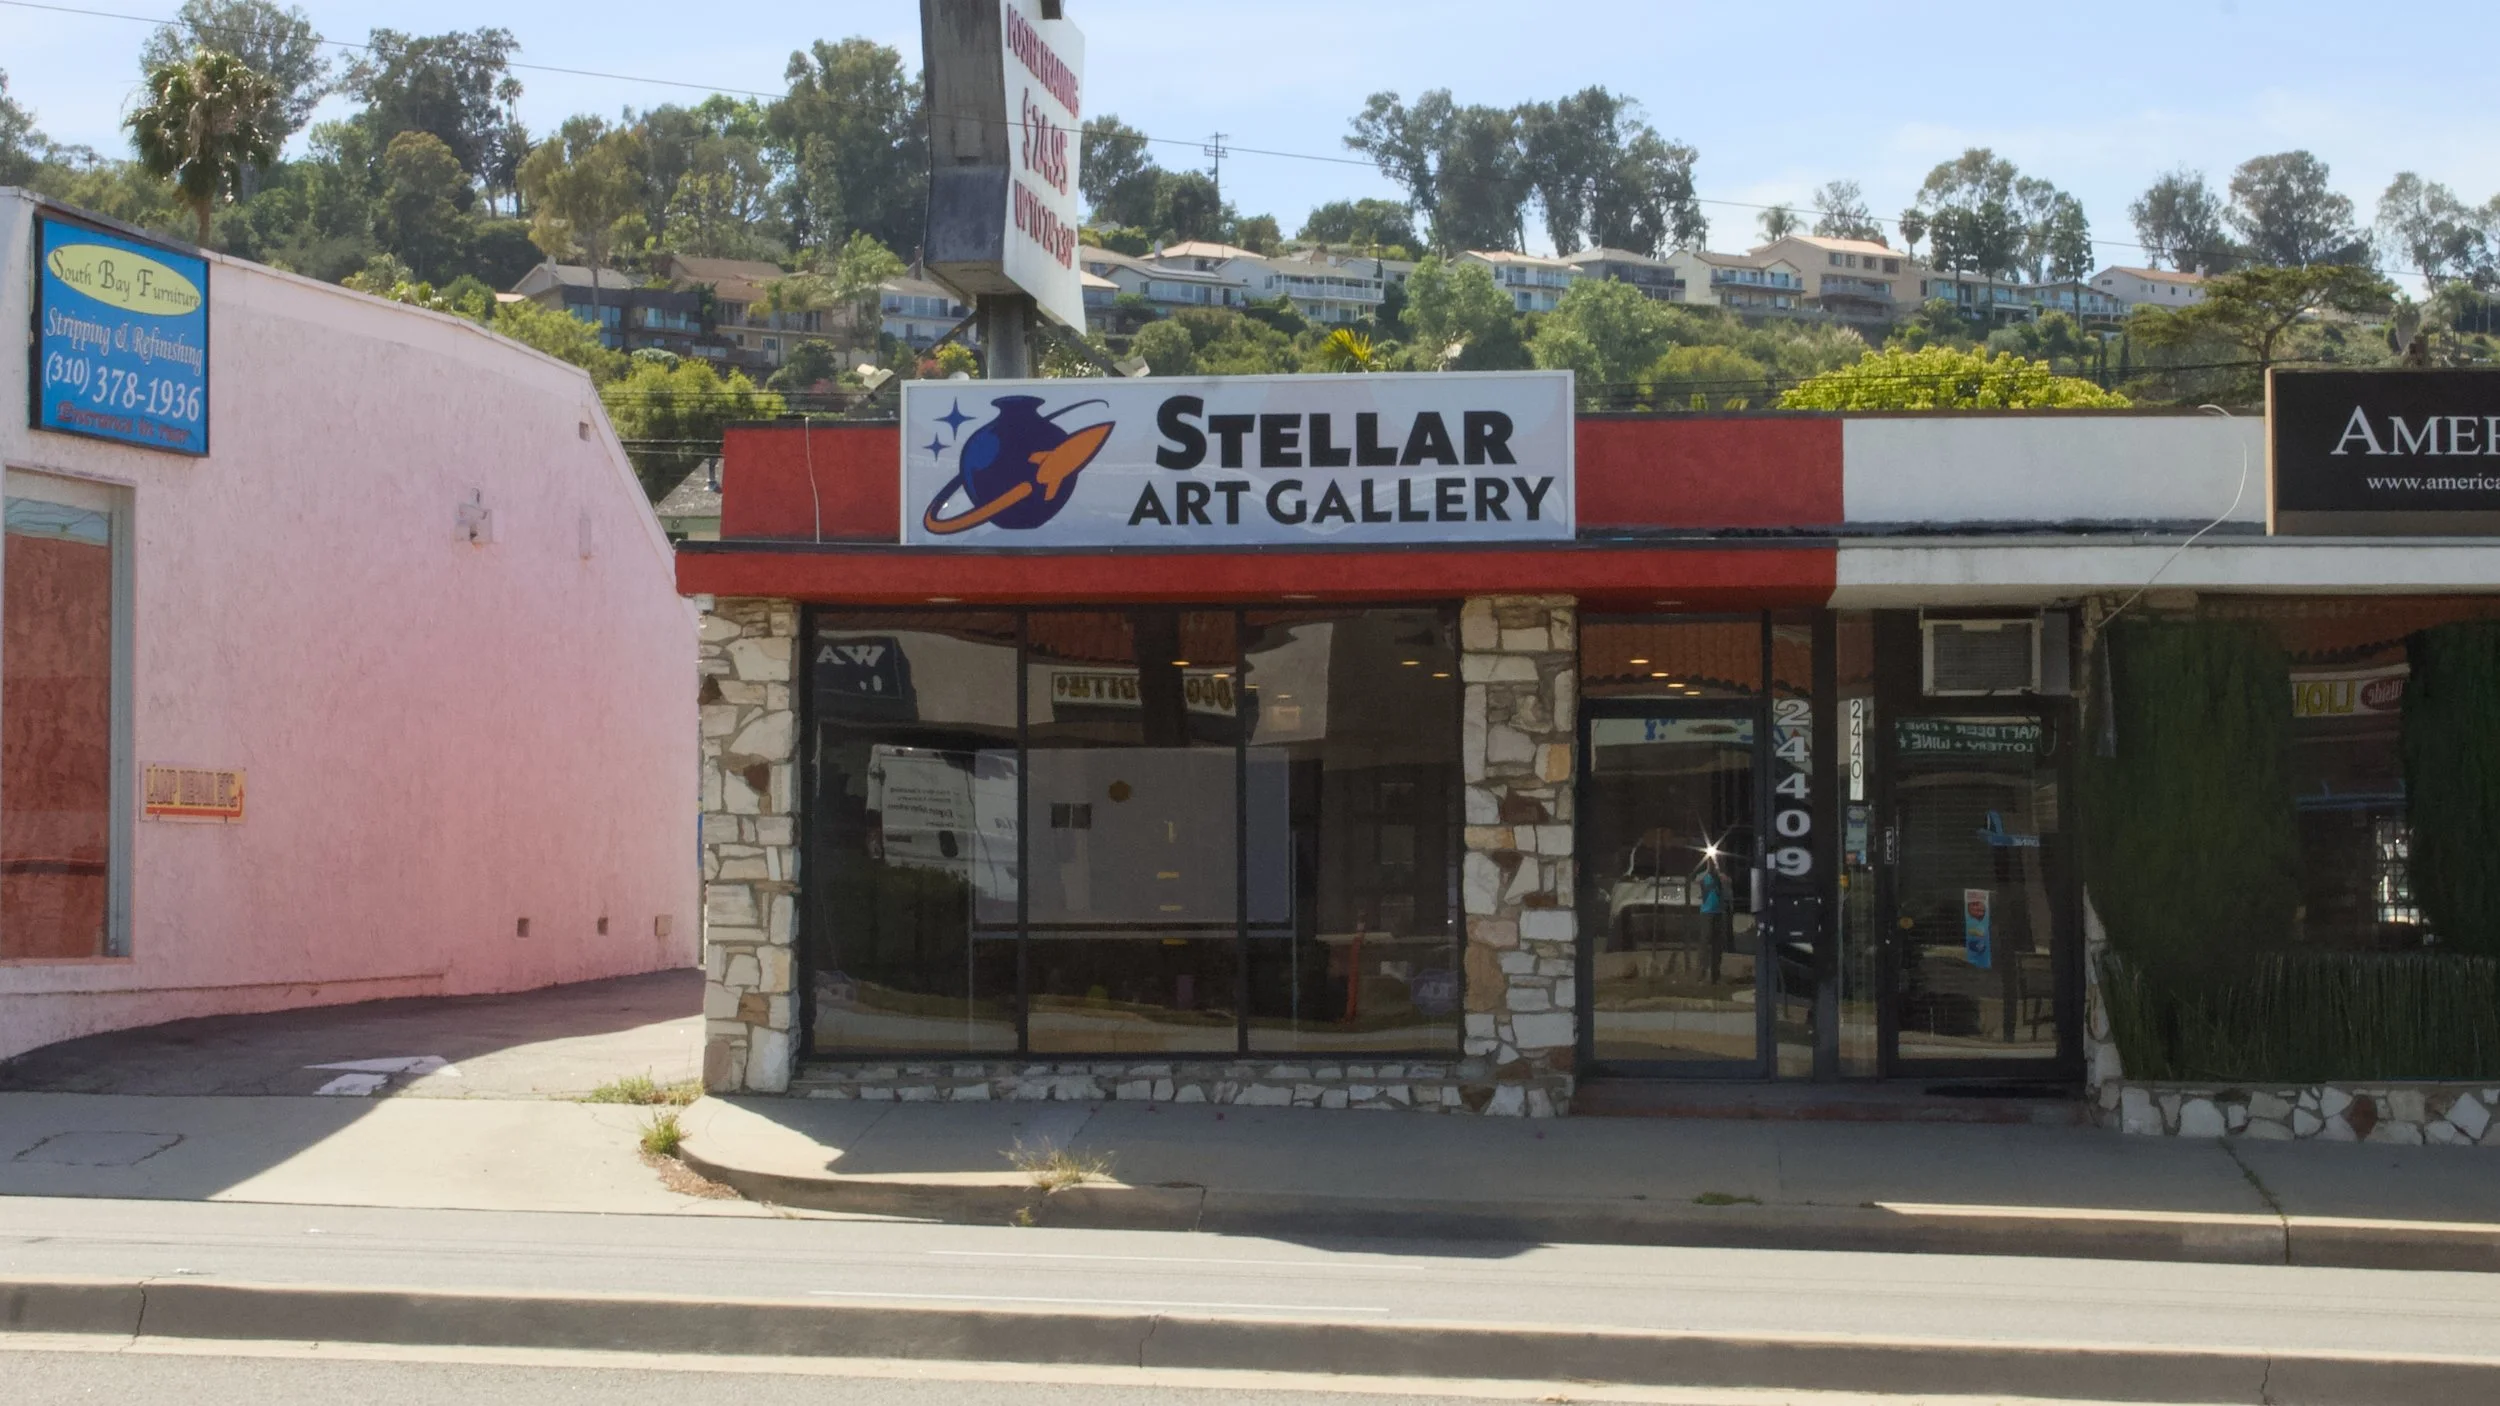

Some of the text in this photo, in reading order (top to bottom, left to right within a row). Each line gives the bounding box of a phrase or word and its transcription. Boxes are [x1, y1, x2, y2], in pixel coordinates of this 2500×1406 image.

[1007, 3, 1079, 119] POSTER FRAMING
[52, 249, 201, 309] South Bay Furniture
[45, 306, 111, 357] Stripping
[133, 326, 203, 376] Refinishing
[45, 350, 202, 422] (310) 378-1936
[1155, 395, 1517, 470] STELLAR
[1127, 476, 1555, 526] ART GALLERY
[1775, 698, 1813, 878] 24409
